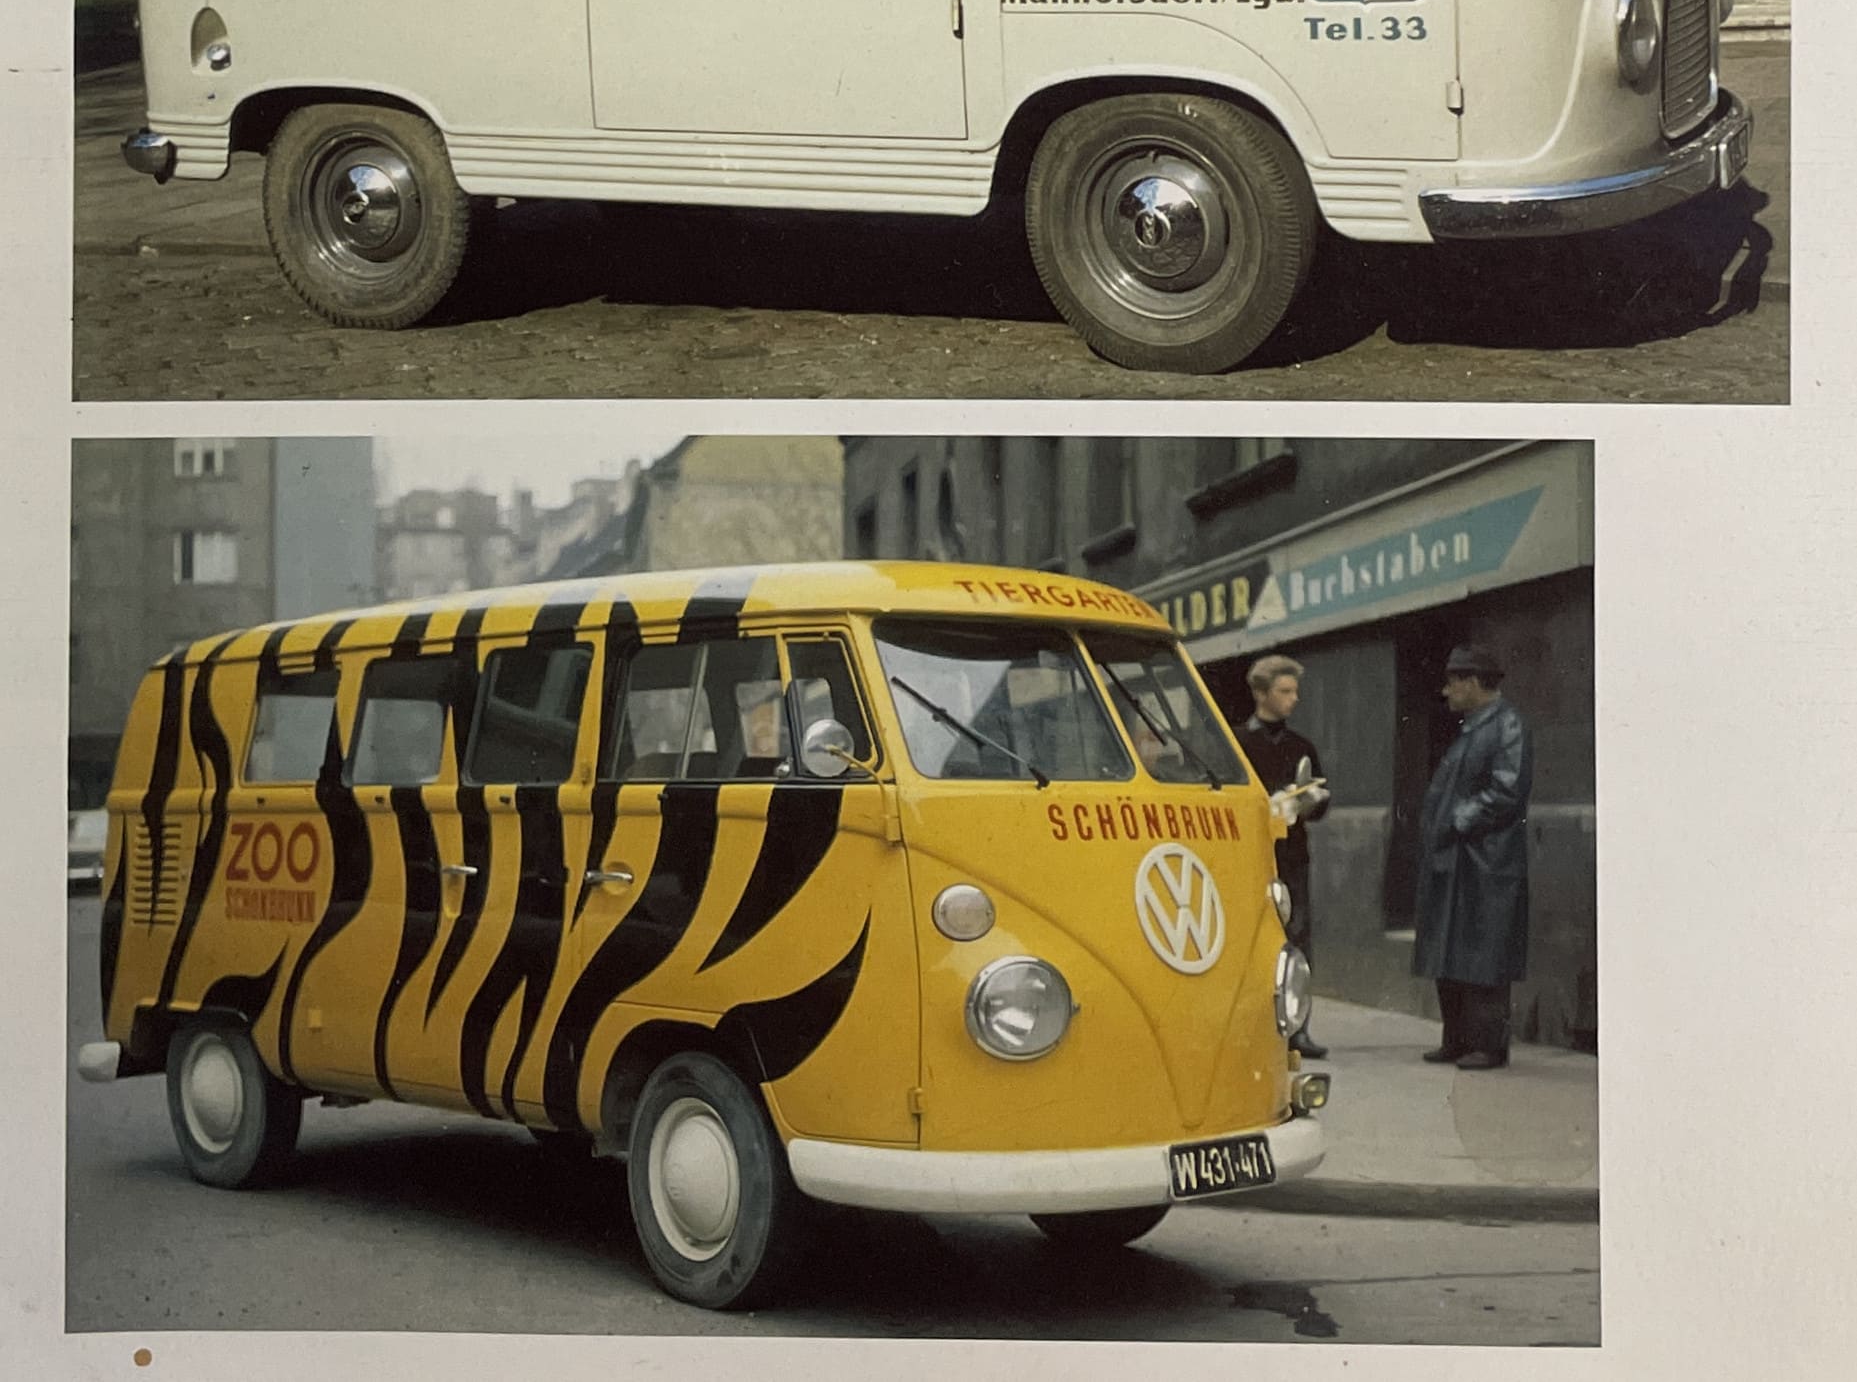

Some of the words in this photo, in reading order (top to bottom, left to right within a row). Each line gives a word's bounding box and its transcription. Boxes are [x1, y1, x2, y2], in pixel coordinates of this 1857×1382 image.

[1289, 530, 1471, 612] Buchstaben
[953, 580, 1157, 621] TIERGARTEN
[1047, 796, 1241, 842] SCHÖNBRUNN
[225, 821, 320, 883] ZOO
